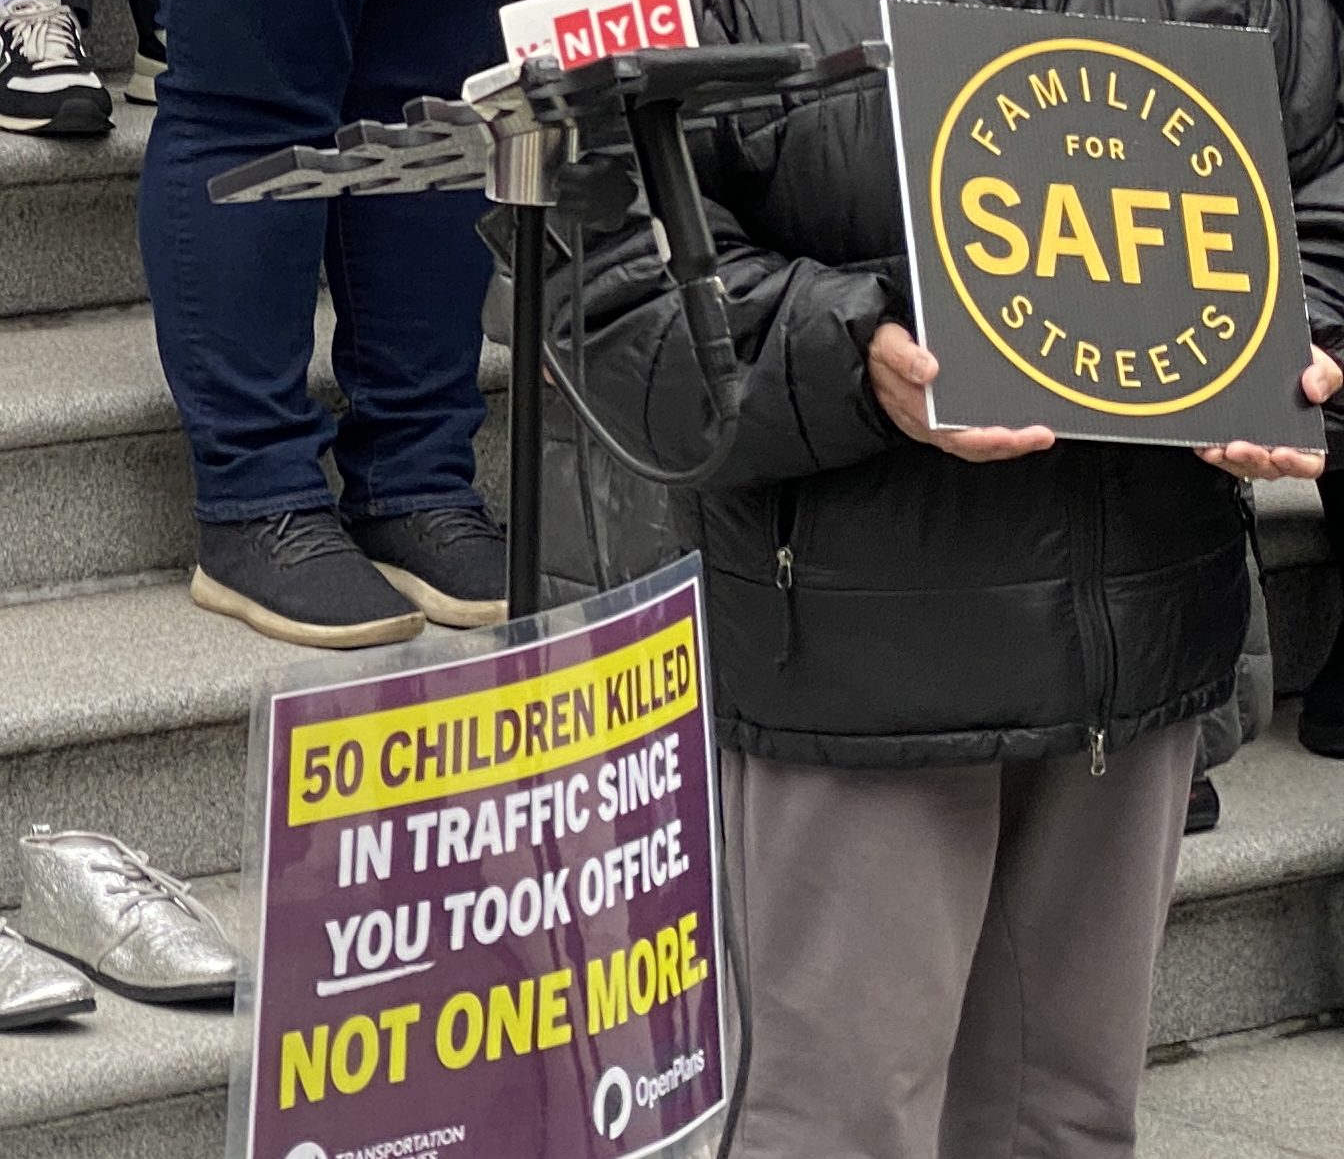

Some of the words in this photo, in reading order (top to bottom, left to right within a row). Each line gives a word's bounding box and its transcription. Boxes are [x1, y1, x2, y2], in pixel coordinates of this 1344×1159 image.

[516, 5, 675, 61] NYC
[971, 67, 1224, 178] FAMILIES
[1065, 134, 1126, 161] FOR
[960, 176, 1252, 293] SAFE
[1001, 294, 1237, 389] STREETS
[302, 745, 364, 804] 50
[379, 682, 596, 788] CHILDREN
[606, 643, 691, 730] KILLED
[338, 821, 393, 888] IN
[407, 772, 591, 874] TRAFFIC
[597, 732, 682, 823] SINCE
[325, 901, 432, 978] YOU
[444, 867, 572, 953] TOOK
[579, 818, 690, 917] OFFICE.
[279, 1004, 421, 1110] NOT
[435, 968, 573, 1071] ONE
[587, 912, 709, 1036] MORE.
[634, 1048, 705, 1110] OpenPlans
